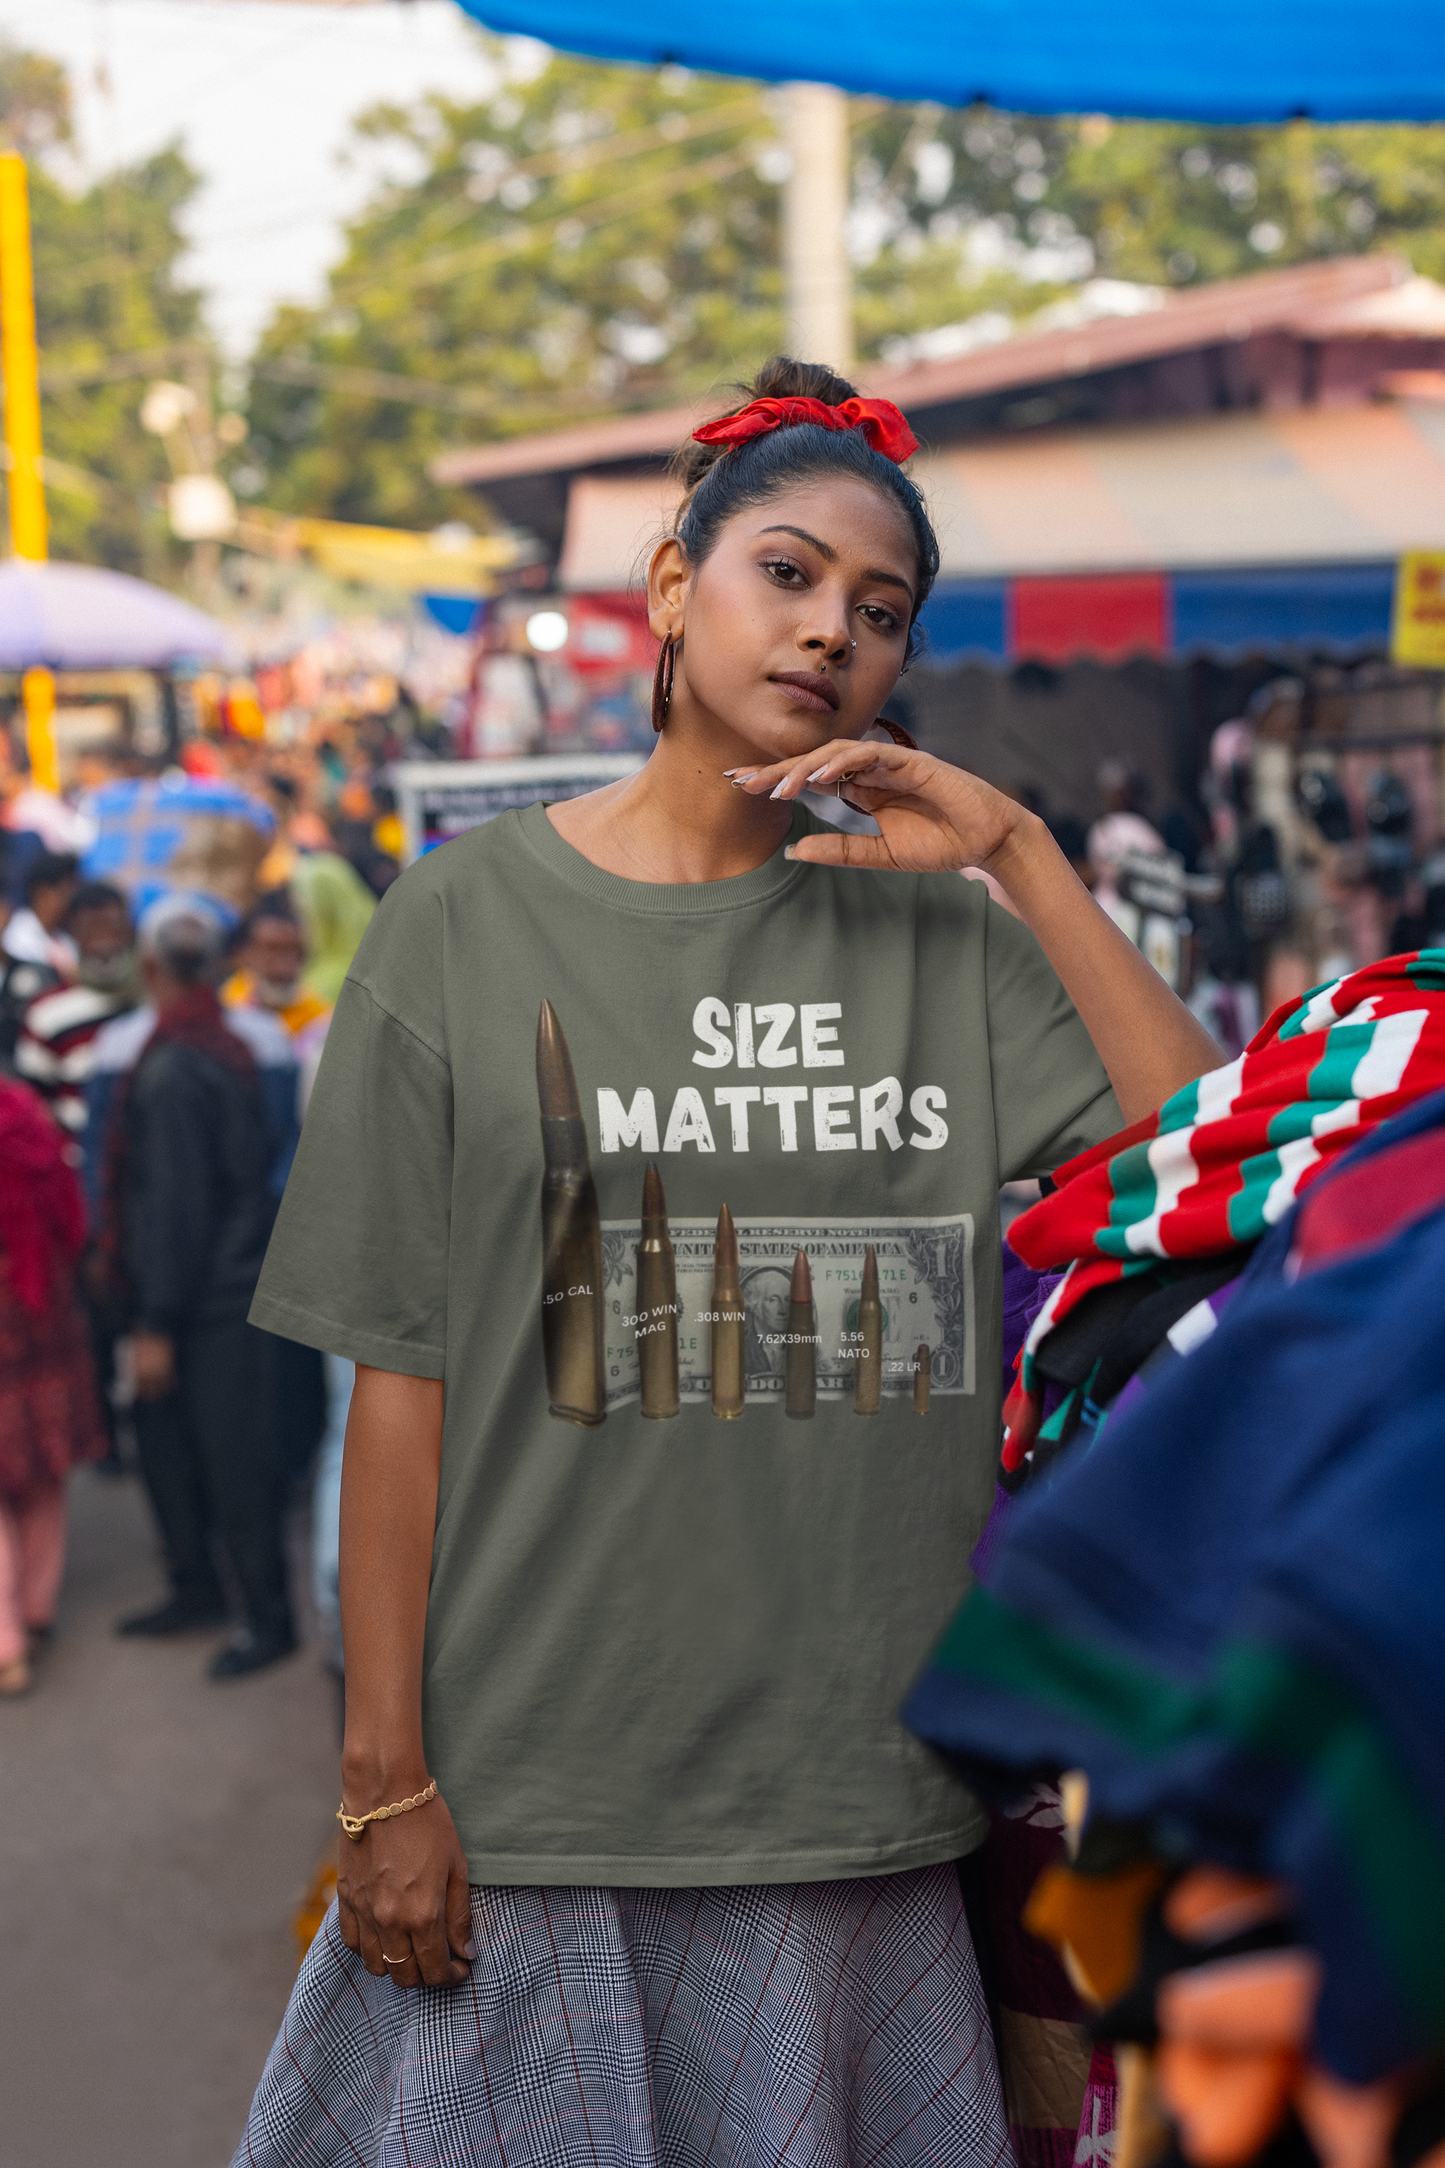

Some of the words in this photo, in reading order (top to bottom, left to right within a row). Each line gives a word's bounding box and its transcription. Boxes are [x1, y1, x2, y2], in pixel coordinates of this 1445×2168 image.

[692, 996, 845, 1068] SIZE
[597, 1076, 949, 1153] MATTERS
[740, 1242, 800, 1256] STATES
[542, 1292, 564, 1304] .50
[567, 1285, 593, 1296] CAL
[909, 1292, 918, 1304] 6
[612, 1300, 621, 1315] 6
[622, 1311, 648, 1327] 300
[652, 1304, 677, 1317] WIN
[694, 1312, 720, 1322] .308
[722, 1312, 746, 1322] WIN
[635, 1321, 667, 1339] MAG
[840, 1332, 864, 1342] 5.56
[838, 1348, 870, 1359] NATO
[610, 1366, 620, 1377] 6
[888, 1362, 904, 1372] .22
[907, 1362, 921, 1372] LR
